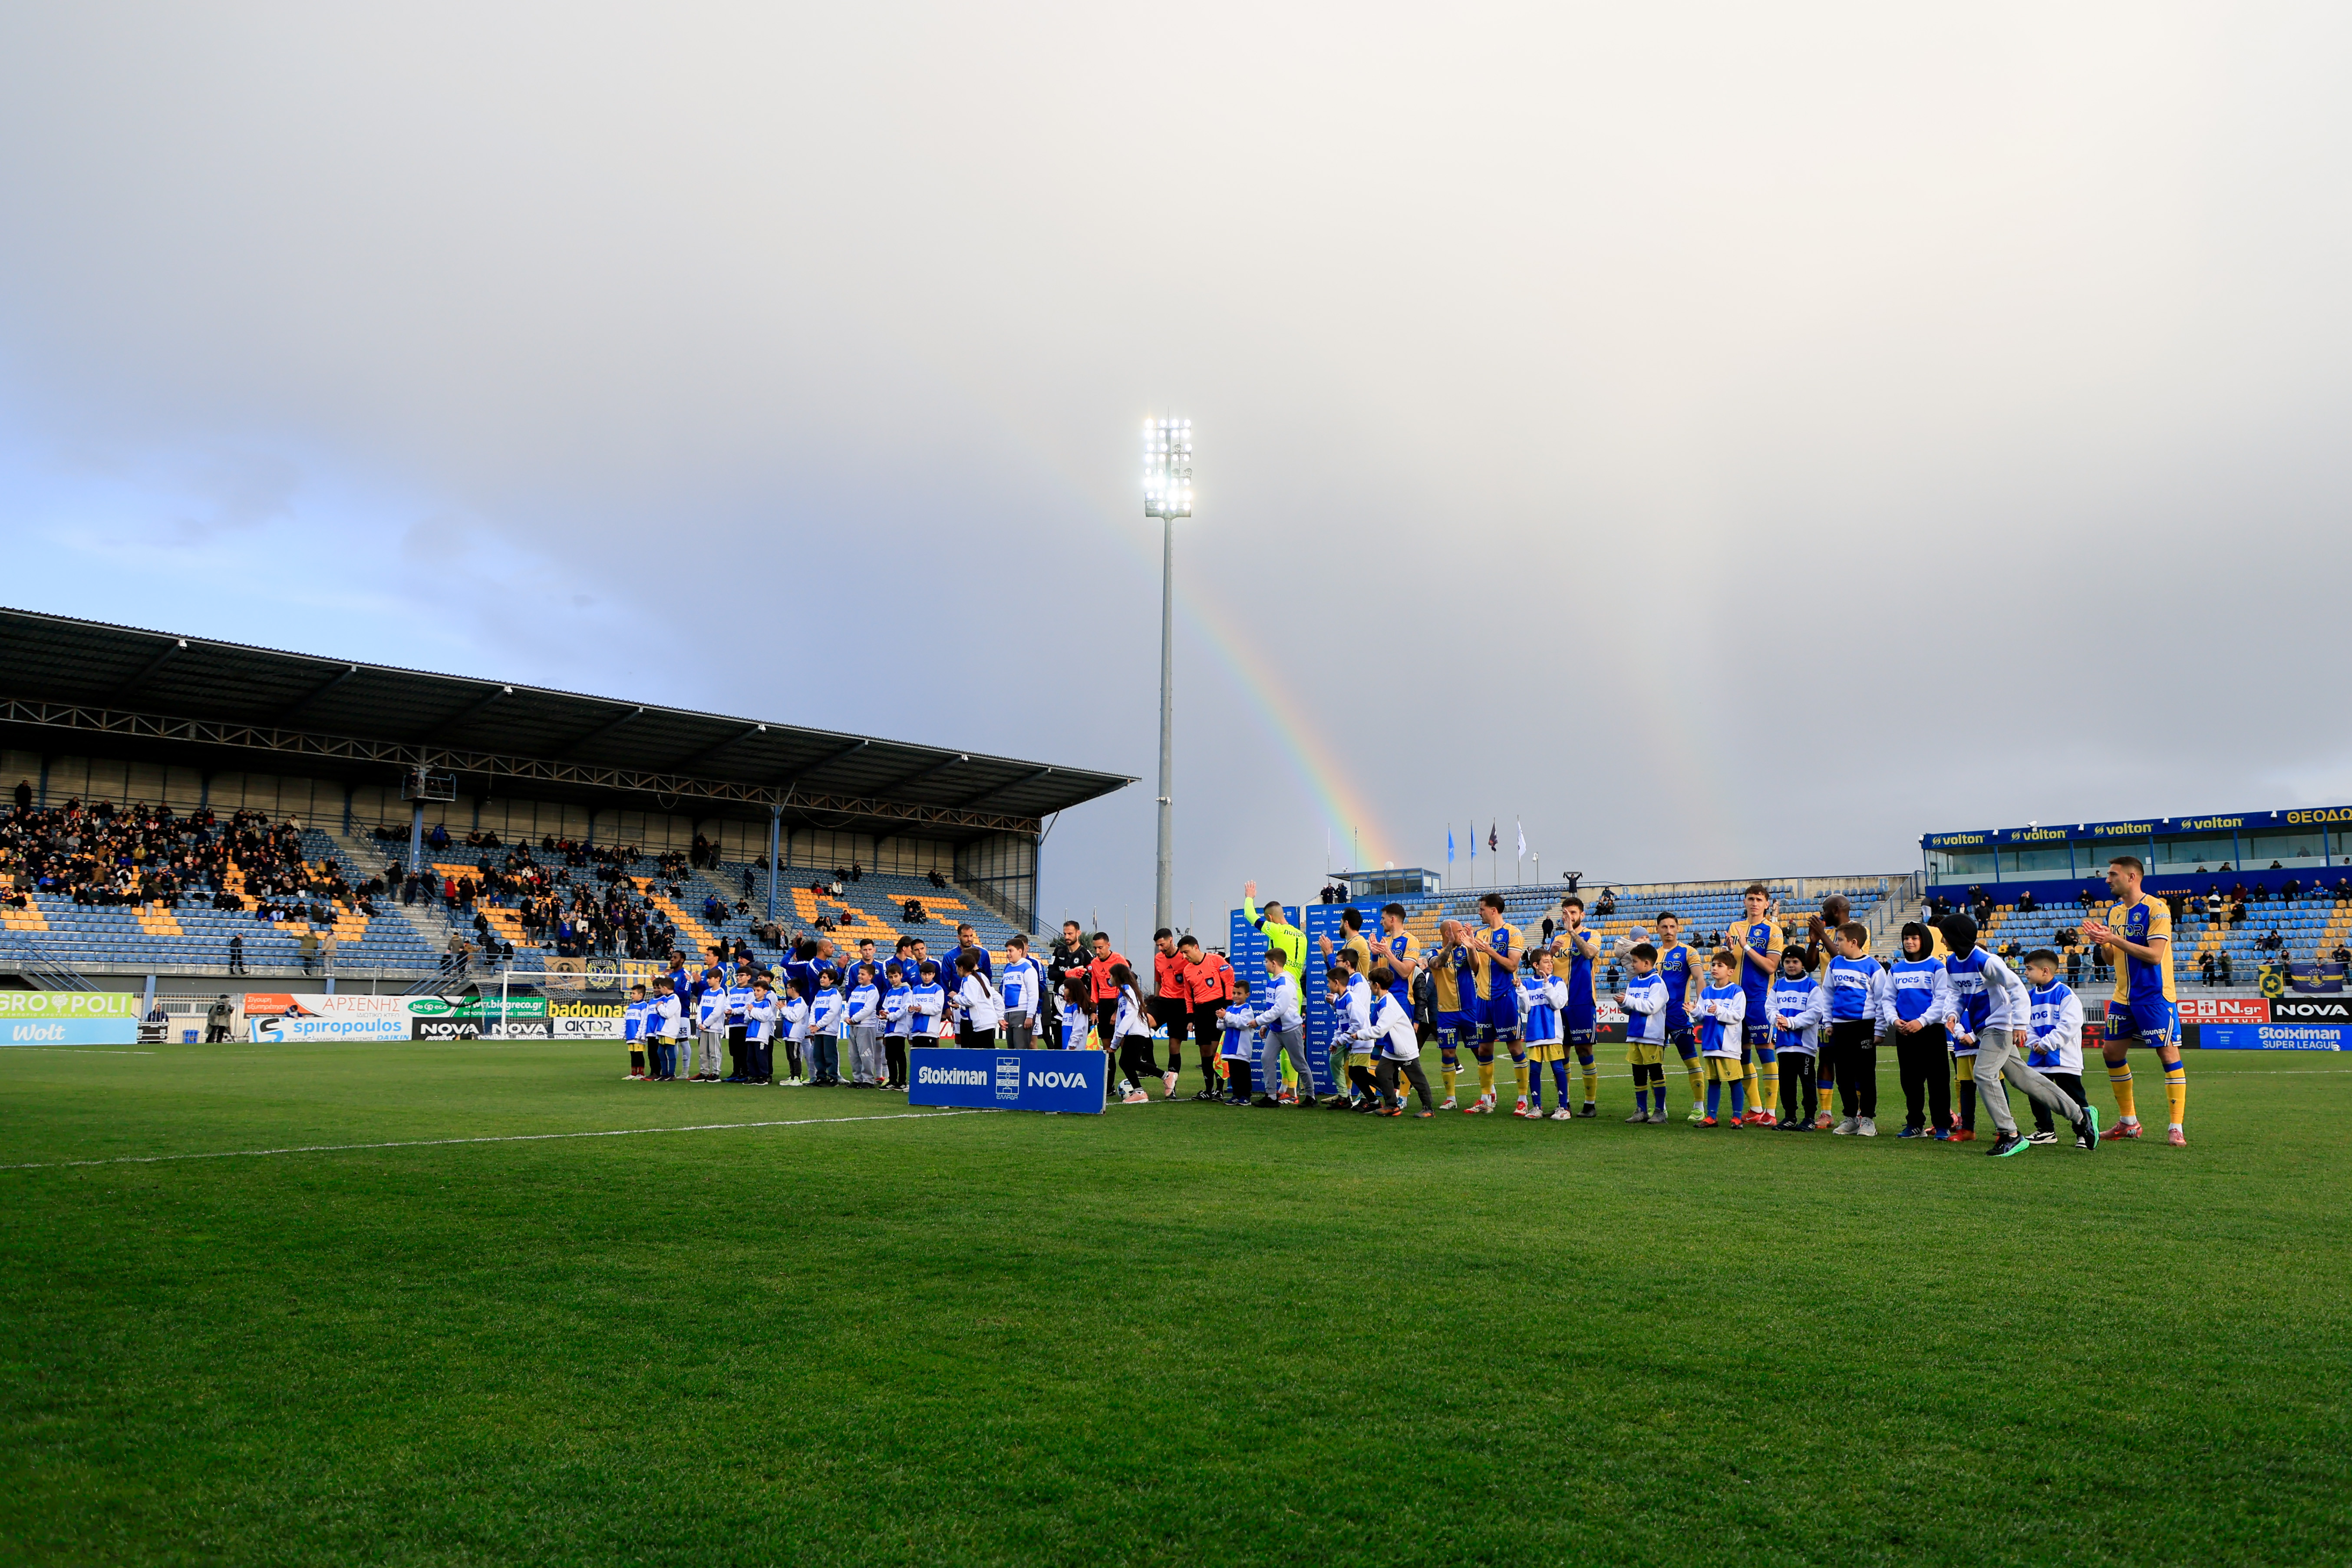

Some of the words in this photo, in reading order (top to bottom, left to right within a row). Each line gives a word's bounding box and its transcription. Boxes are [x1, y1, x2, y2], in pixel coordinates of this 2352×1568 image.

[2106, 823, 2151, 835] volton
[2194, 817, 2242, 829] volton
[1943, 834, 1983, 845] volton
[2023, 829, 2066, 840] volton
[1833, 974, 1855, 983] iroes
[71, 996, 126, 1013] POLI
[322, 997, 400, 1011] ΑΡΣΕΝΗΣ
[2277, 1004, 2349, 1016] NOVA
[13, 1023, 66, 1041] Wolt
[294, 1018, 401, 1036] spiropoulos
[420, 1023, 479, 1034] NOVA
[492, 1023, 548, 1033] NOVA
[2107, 1020, 2118, 1034] 41
[2259, 1027, 2340, 1040] Stoiximan
[919, 1066, 987, 1085] Stoiximan
[1028, 1072, 1087, 1088] NOVA
